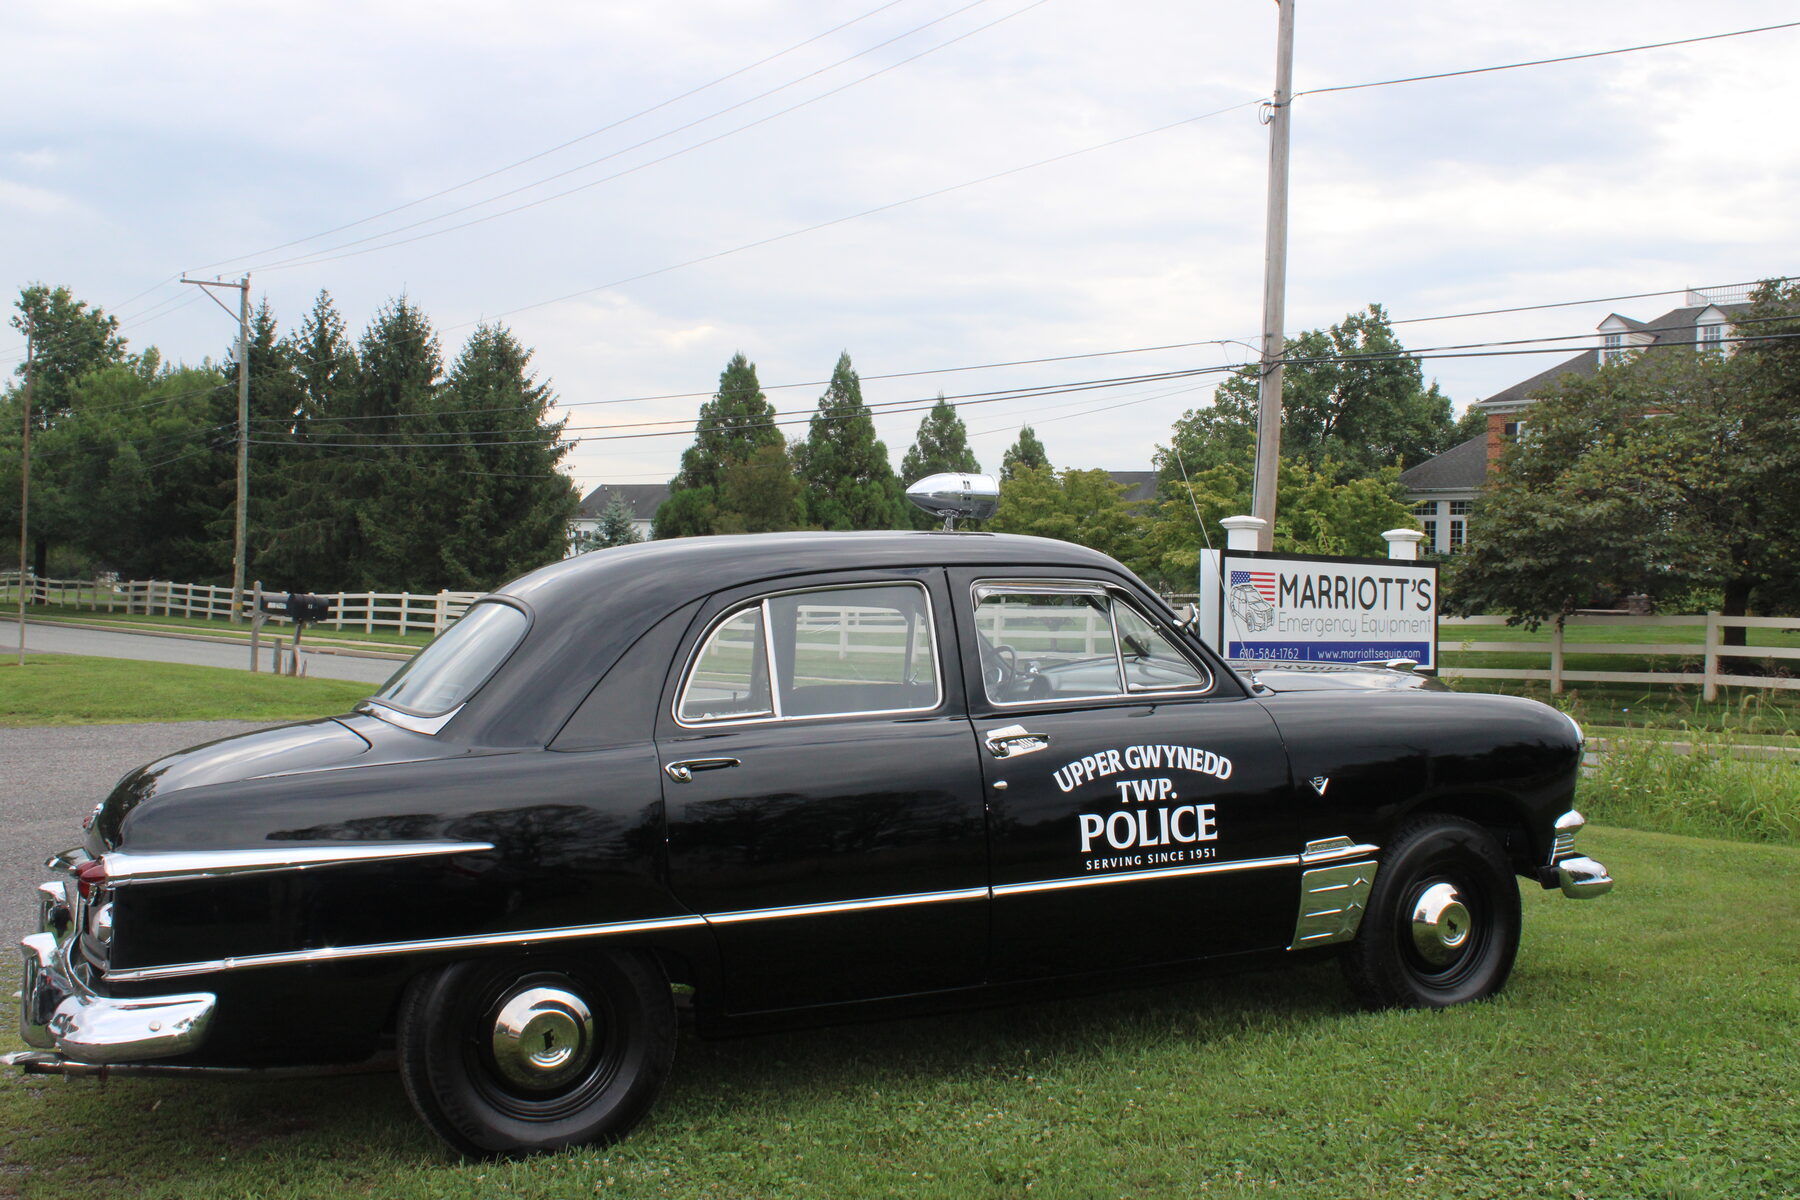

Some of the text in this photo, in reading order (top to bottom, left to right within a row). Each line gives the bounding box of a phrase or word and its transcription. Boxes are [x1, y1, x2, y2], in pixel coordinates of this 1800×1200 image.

[1279, 573, 1431, 611] MARRIOTT'S
[1278, 612, 1431, 638] Emergency Equipment
[1239, 648, 1299, 660] 610-584-1762
[1053, 744, 1232, 792] UPPER GWYNEDD
[1116, 777, 1178, 803] TWP.
[1079, 804, 1218, 852] POLICE
[1086, 847, 1217, 871] SERVING SINCE 1951
